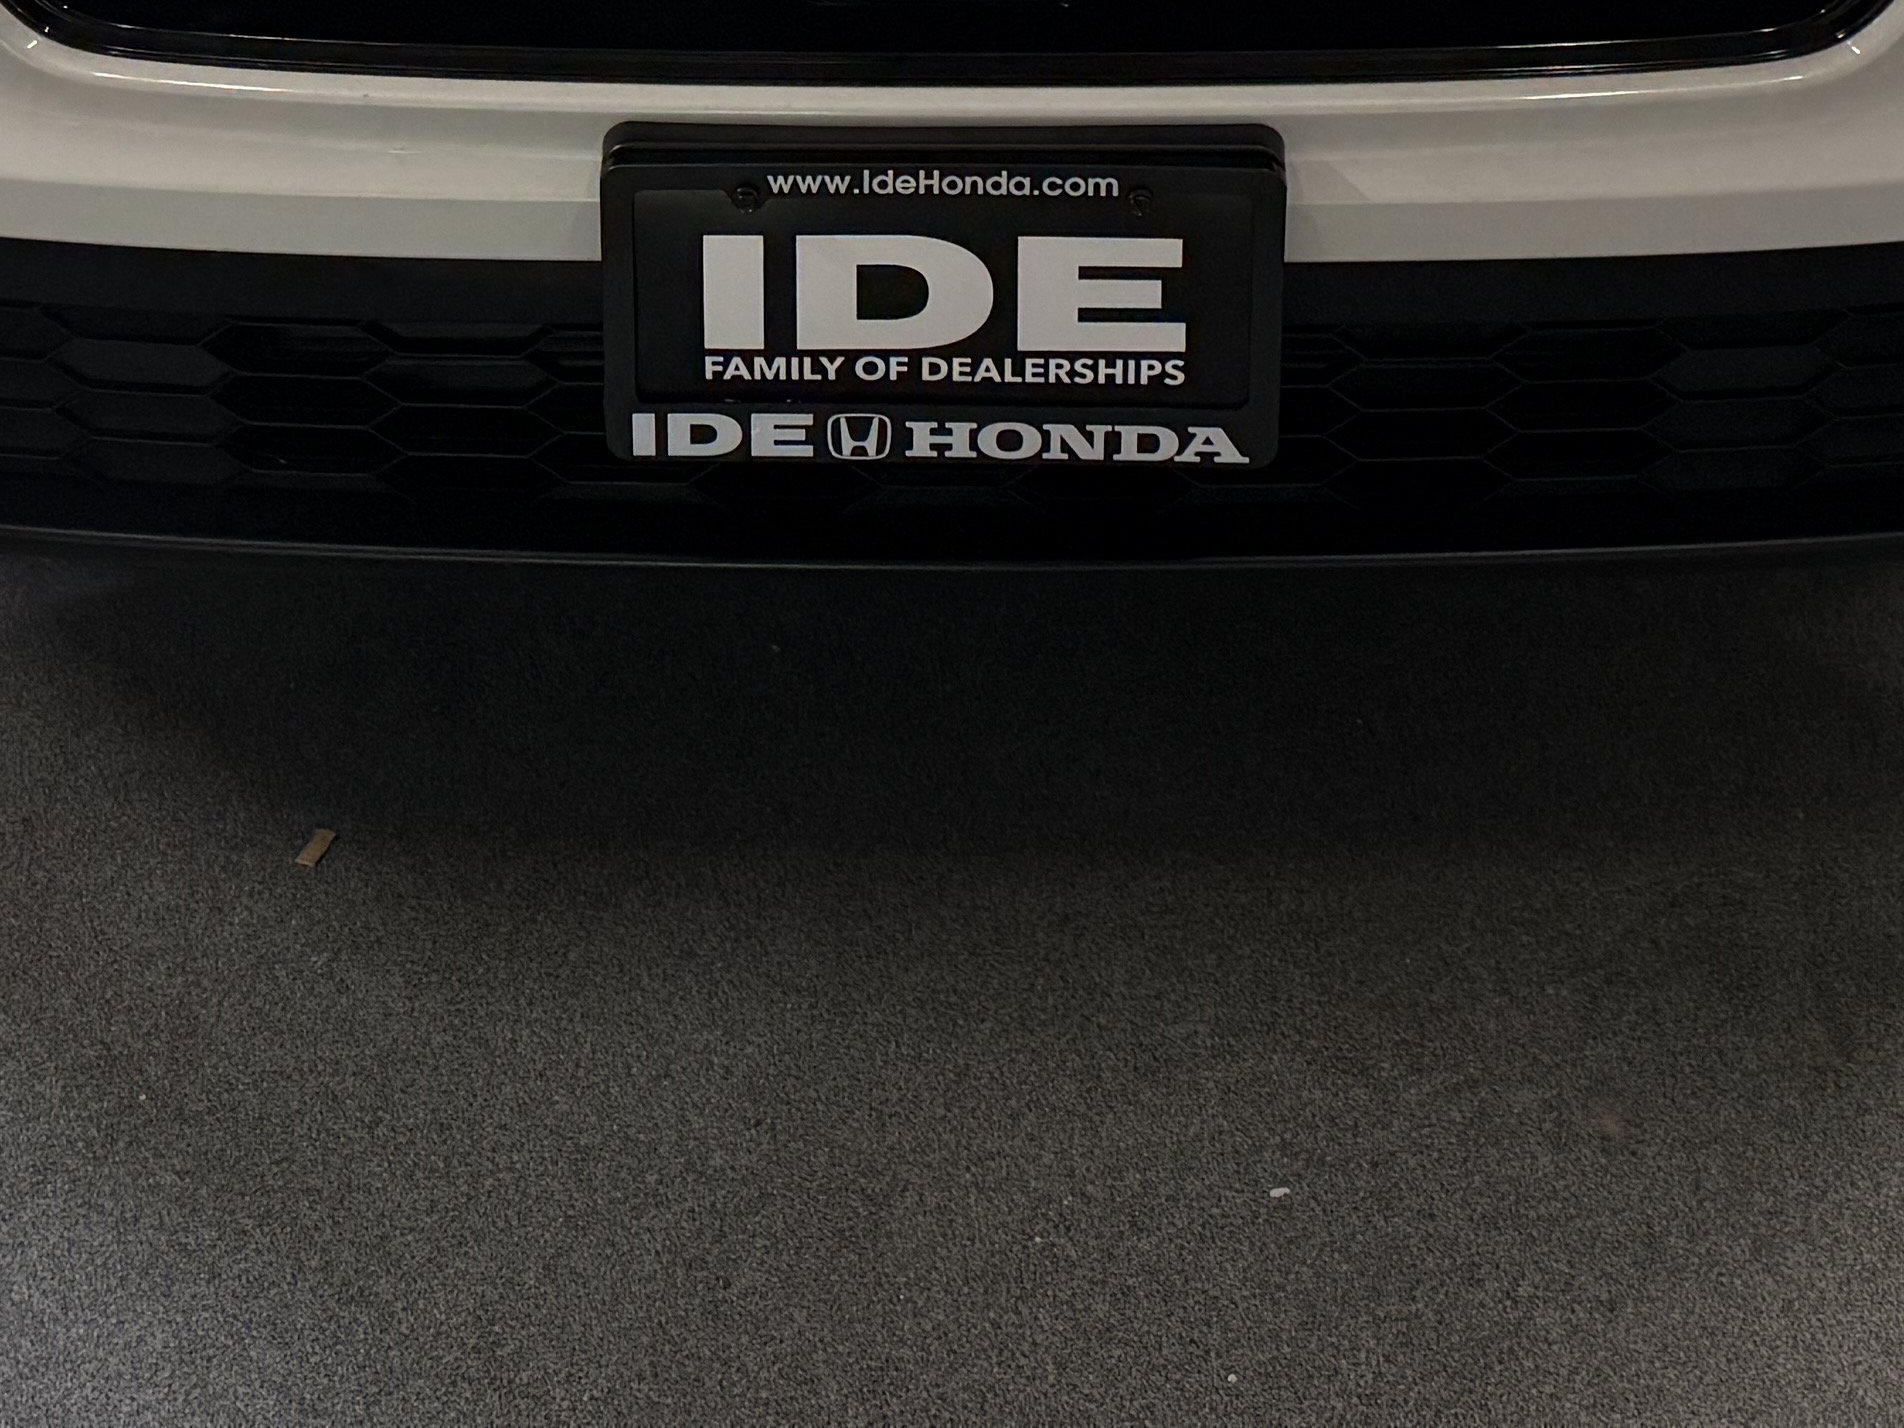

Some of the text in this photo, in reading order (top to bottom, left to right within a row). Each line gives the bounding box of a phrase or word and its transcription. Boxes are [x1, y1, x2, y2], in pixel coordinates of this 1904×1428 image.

[766, 169, 1119, 197] www.IdeHonda.com
[702, 234, 1187, 352] IDE
[704, 355, 1185, 385] FAMILY OF DEALERSHIPS
[631, 413, 1251, 464] IDE HONDA
